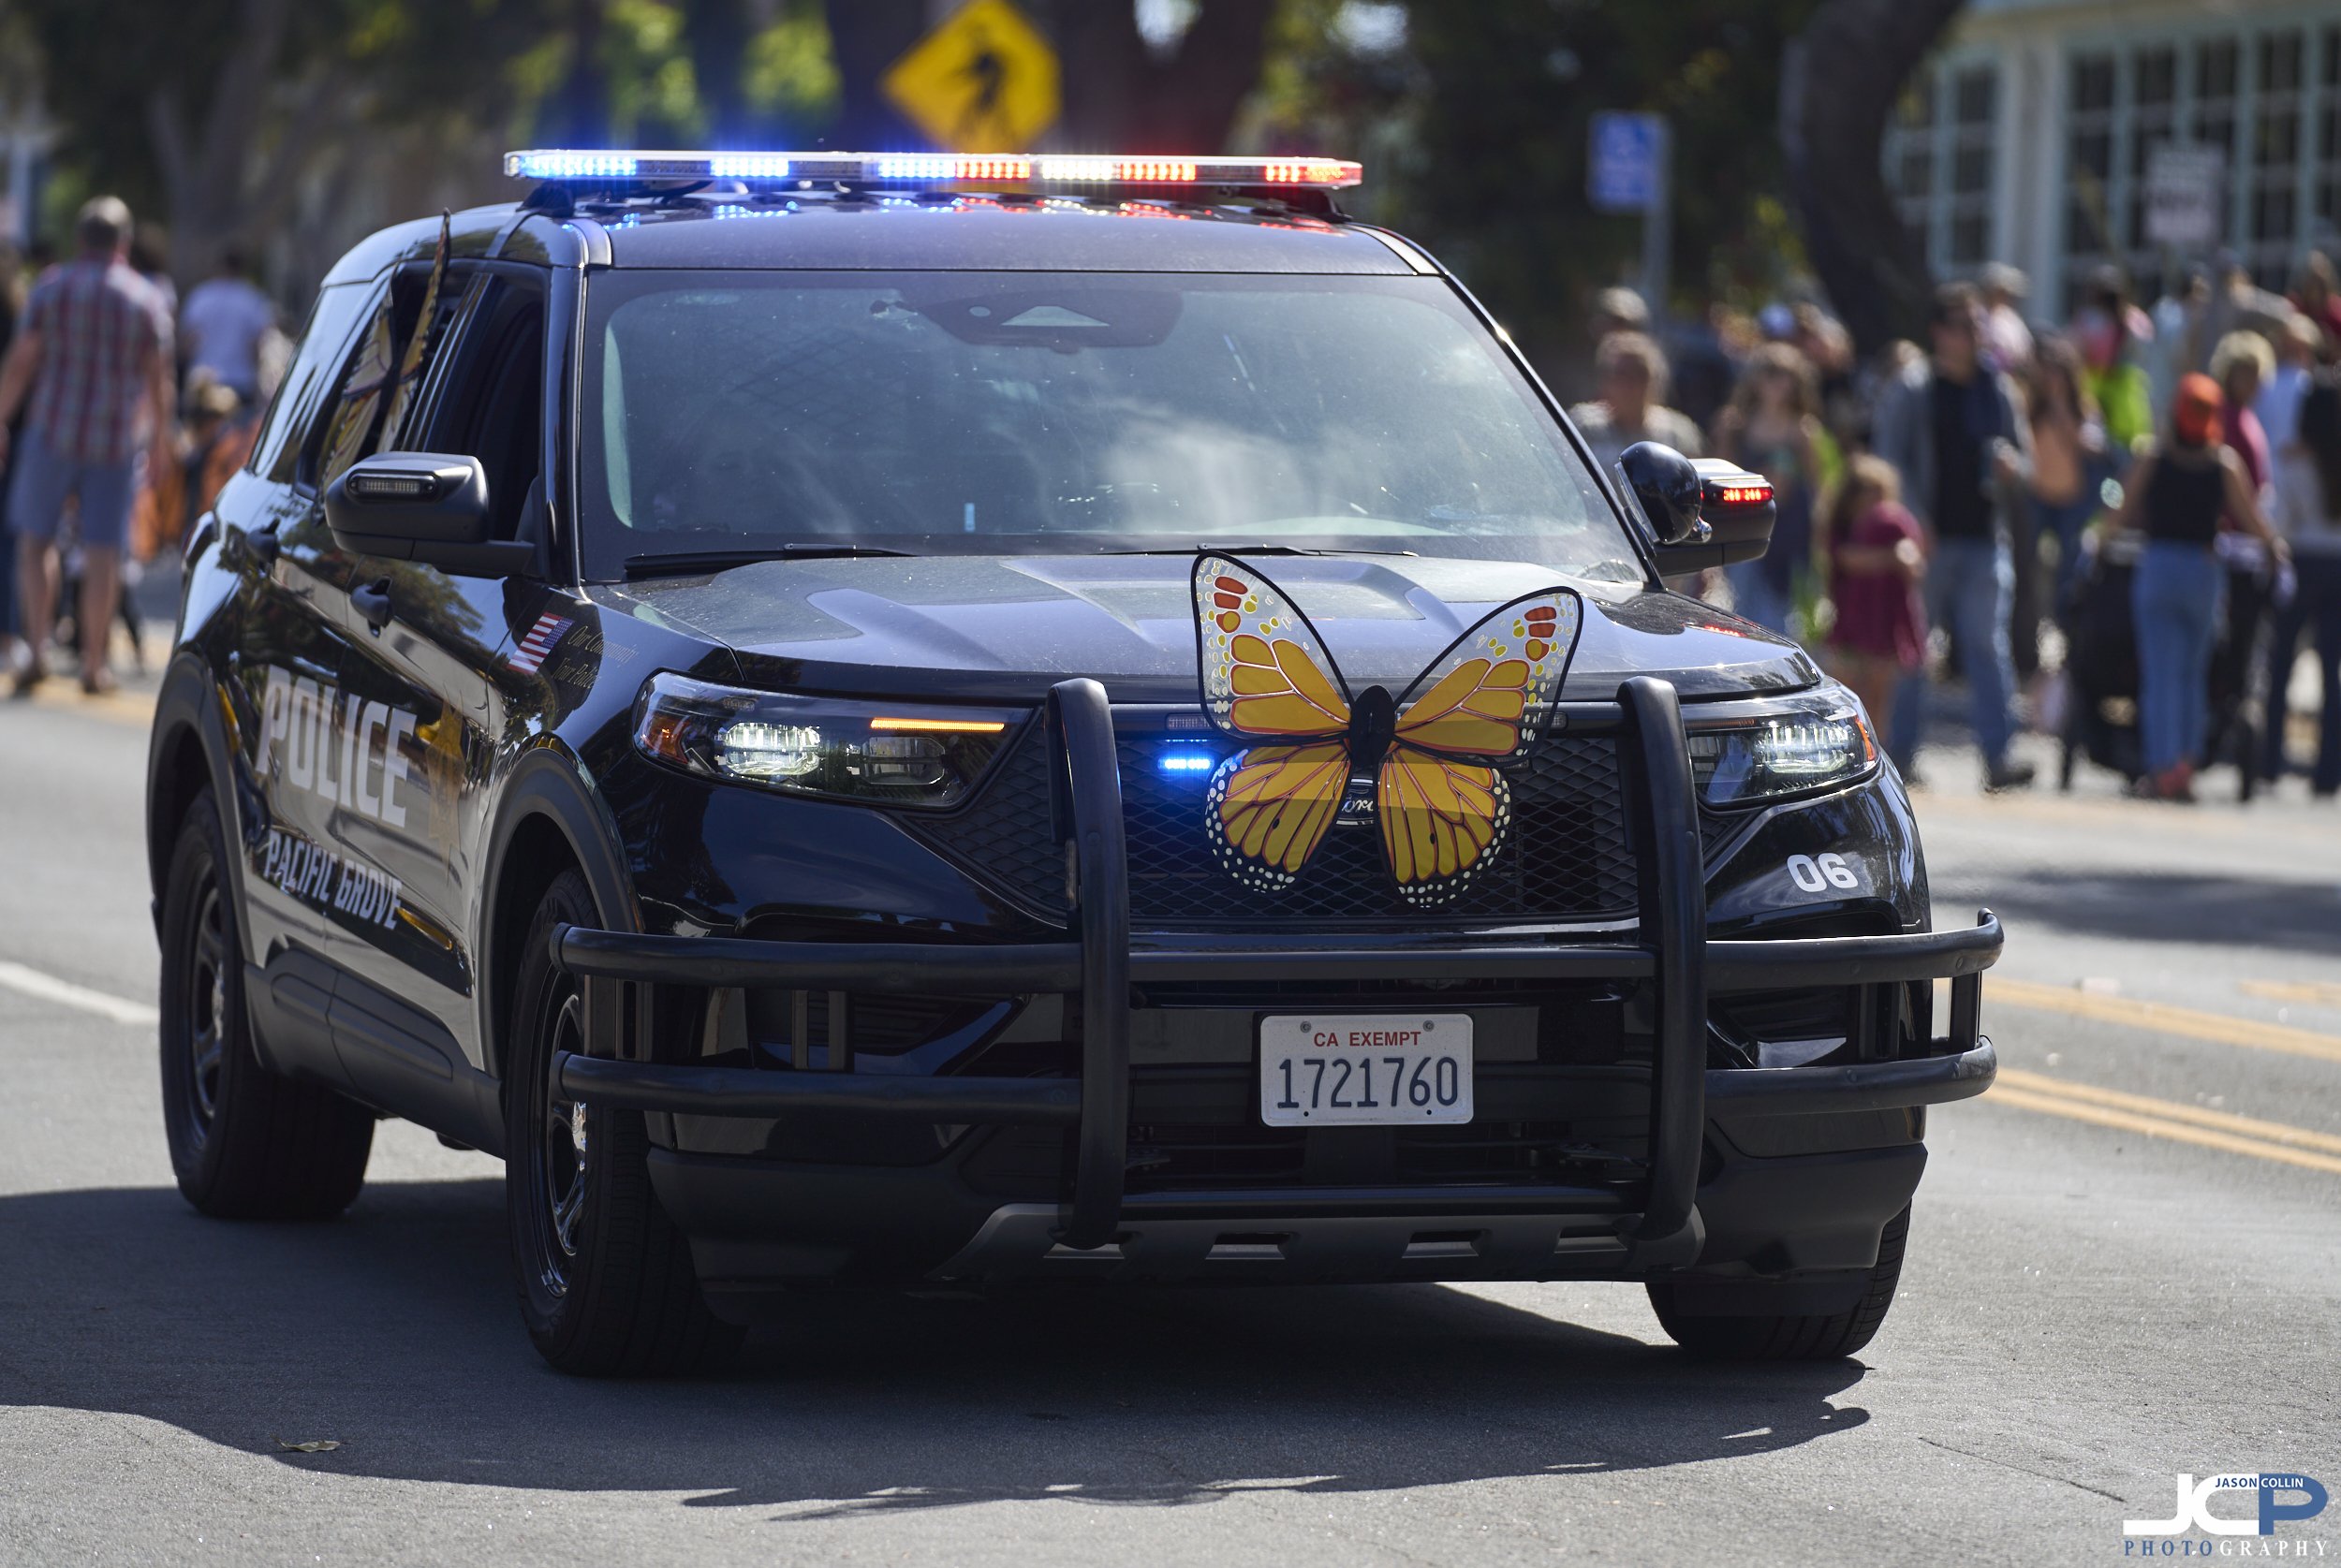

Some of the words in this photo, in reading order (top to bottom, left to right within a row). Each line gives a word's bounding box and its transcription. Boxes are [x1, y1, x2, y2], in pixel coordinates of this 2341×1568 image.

[567, 625, 592, 648] Our
[585, 631, 639, 667] Community
[552, 657, 577, 681] Your
[255, 664, 418, 828] POLICE
[263, 828, 338, 903] PACIFIC
[333, 858, 404, 931] GROVE
[1787, 853, 1859, 892] 06
[1314, 1033, 1339, 1047] CA
[1348, 1032, 1421, 1047] EXEMPT
[1277, 1057, 1458, 1108] 1721760
